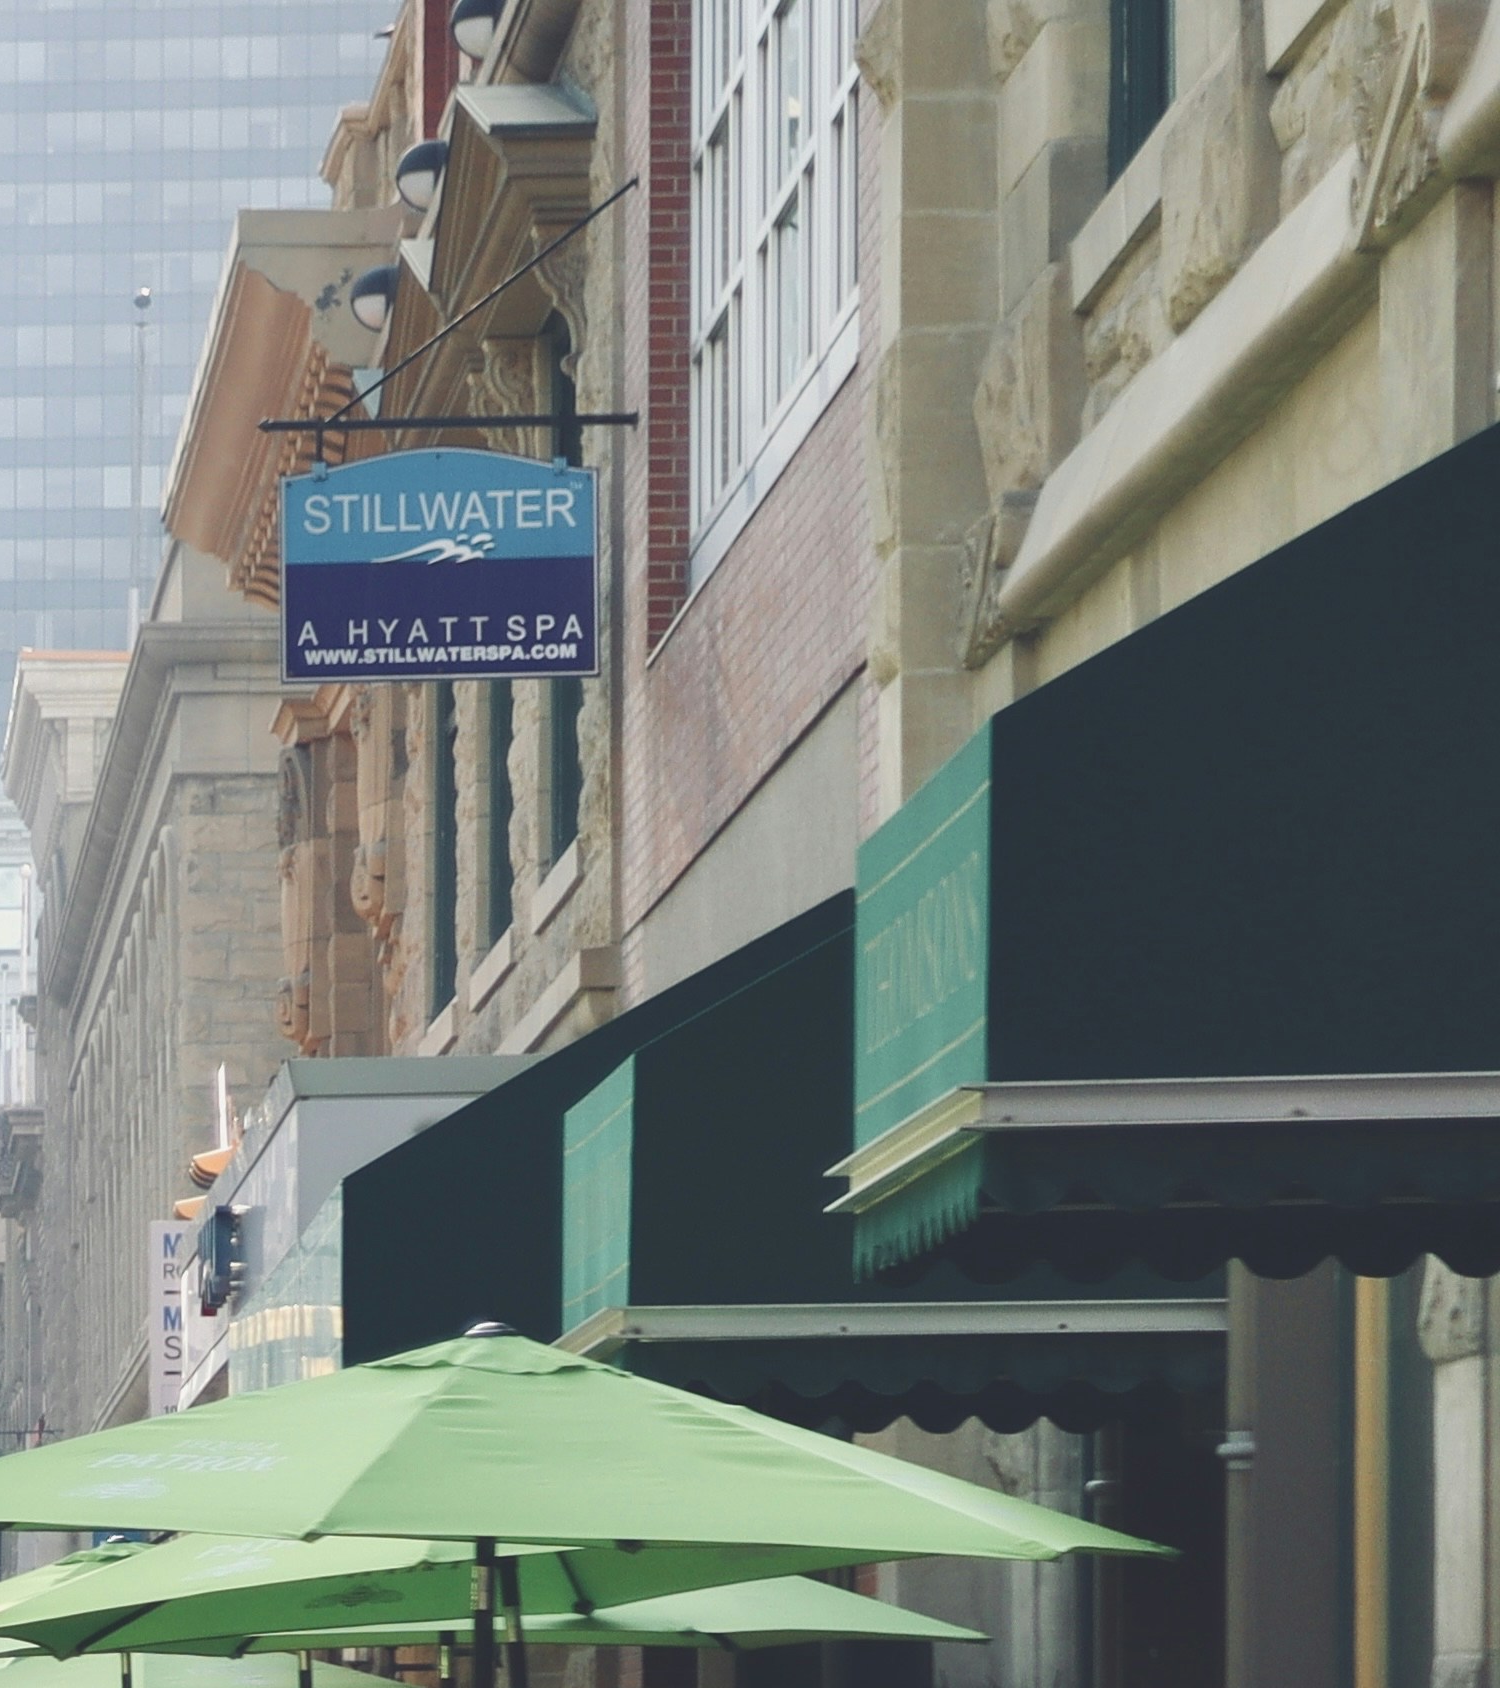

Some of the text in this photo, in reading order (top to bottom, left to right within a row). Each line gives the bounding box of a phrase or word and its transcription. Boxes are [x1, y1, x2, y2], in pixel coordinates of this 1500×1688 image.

[303, 488, 577, 536] STILLWATER
[297, 613, 584, 647] A HYATT SPA
[304, 642, 578, 666] WWW.STILLWATERSPA.COM
